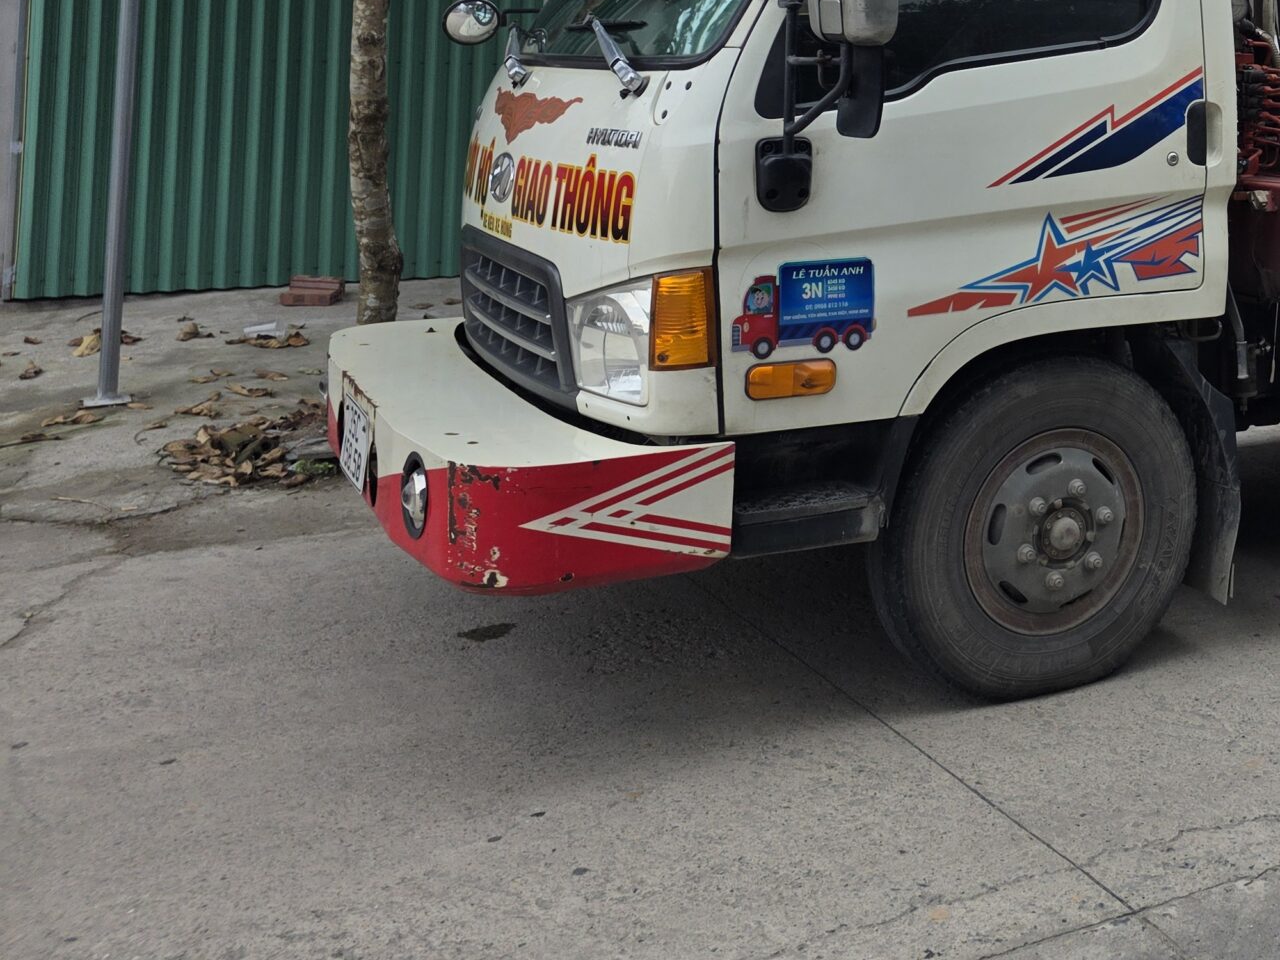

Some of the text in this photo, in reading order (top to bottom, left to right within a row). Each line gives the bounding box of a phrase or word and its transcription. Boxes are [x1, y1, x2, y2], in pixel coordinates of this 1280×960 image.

[511, 155, 553, 227] GIAO
[551, 153, 636, 243] THÔNG
[792, 268, 806, 279] LÊ
[840, 266, 864, 276] ANH
[802, 281, 823, 300] 3N
